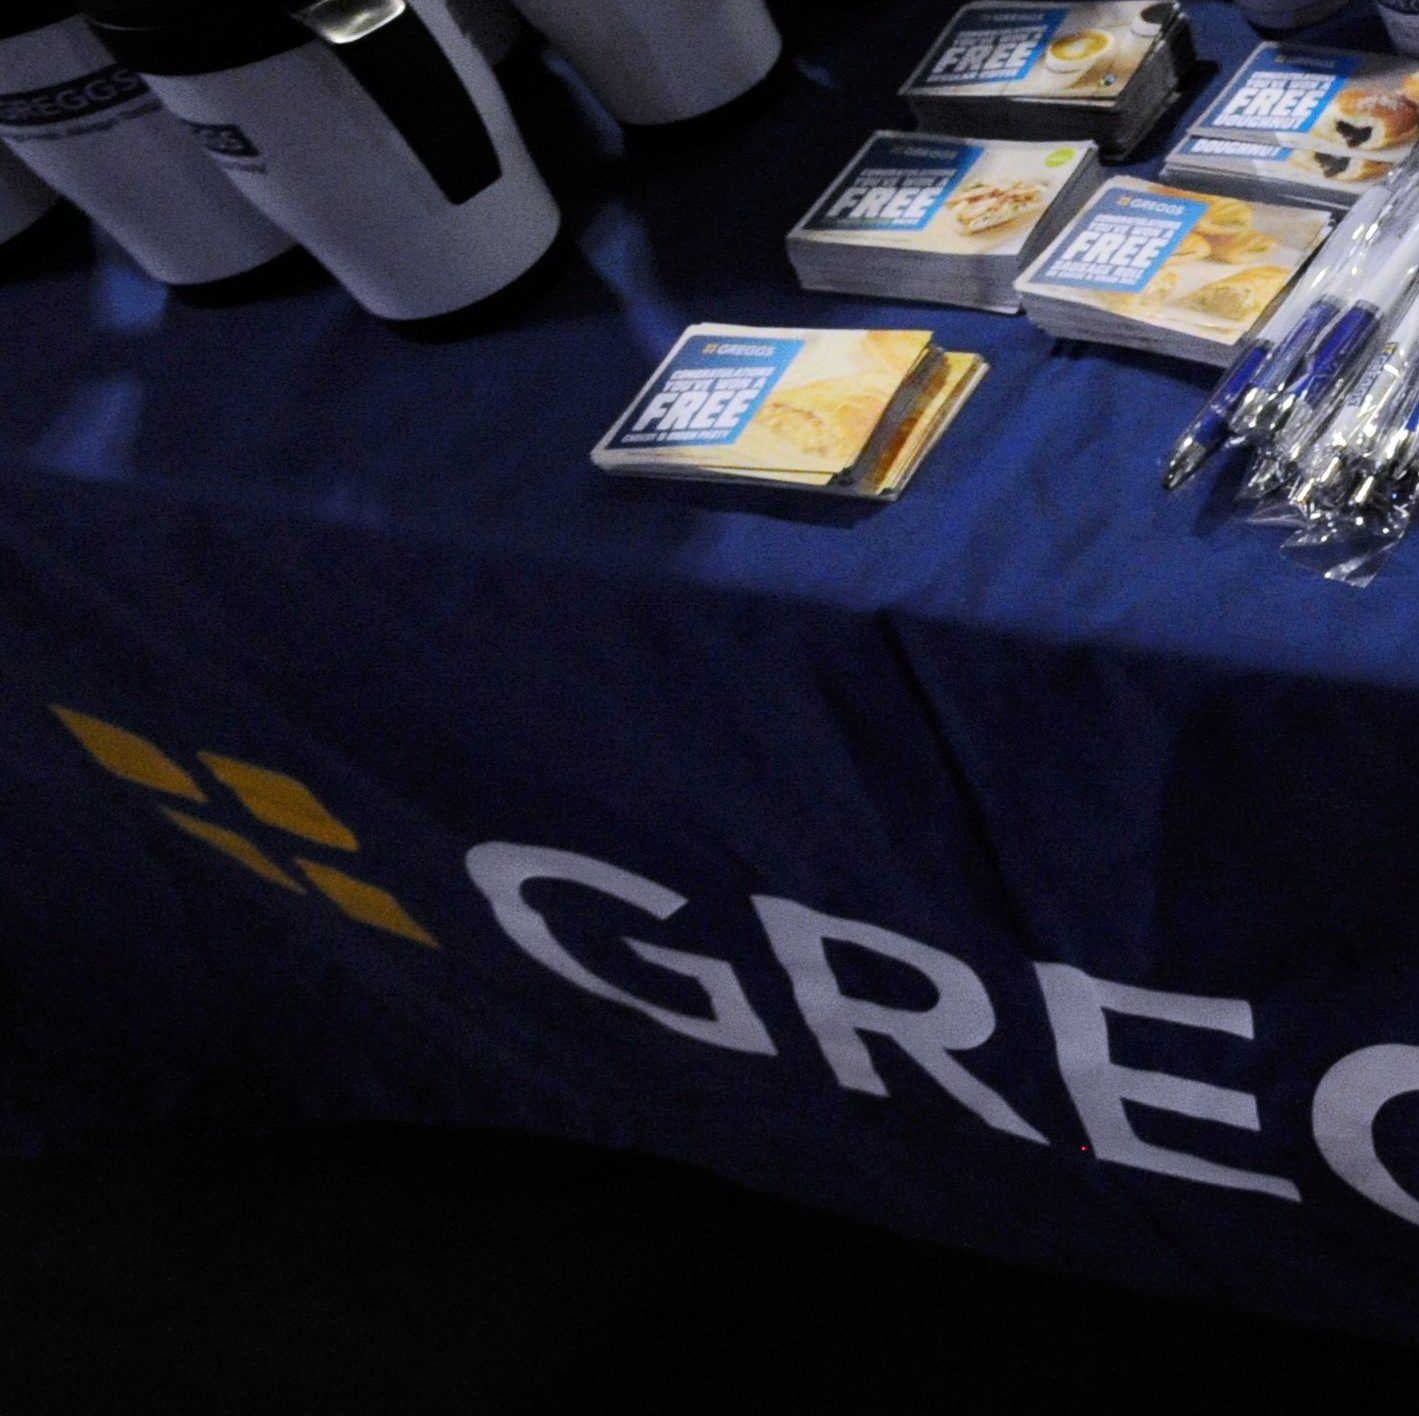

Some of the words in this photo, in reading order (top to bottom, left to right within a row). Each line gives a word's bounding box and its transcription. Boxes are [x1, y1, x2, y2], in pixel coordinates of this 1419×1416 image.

[932, 41, 1037, 74] FREE
[1221, 86, 1328, 117] FREE
[826, 186, 945, 218] FREE
[1130, 198, 1186, 216] GREGGS
[1061, 231, 1170, 269] FREE
[717, 343, 776, 356] GREGGS
[632, 389, 761, 431] FREE
